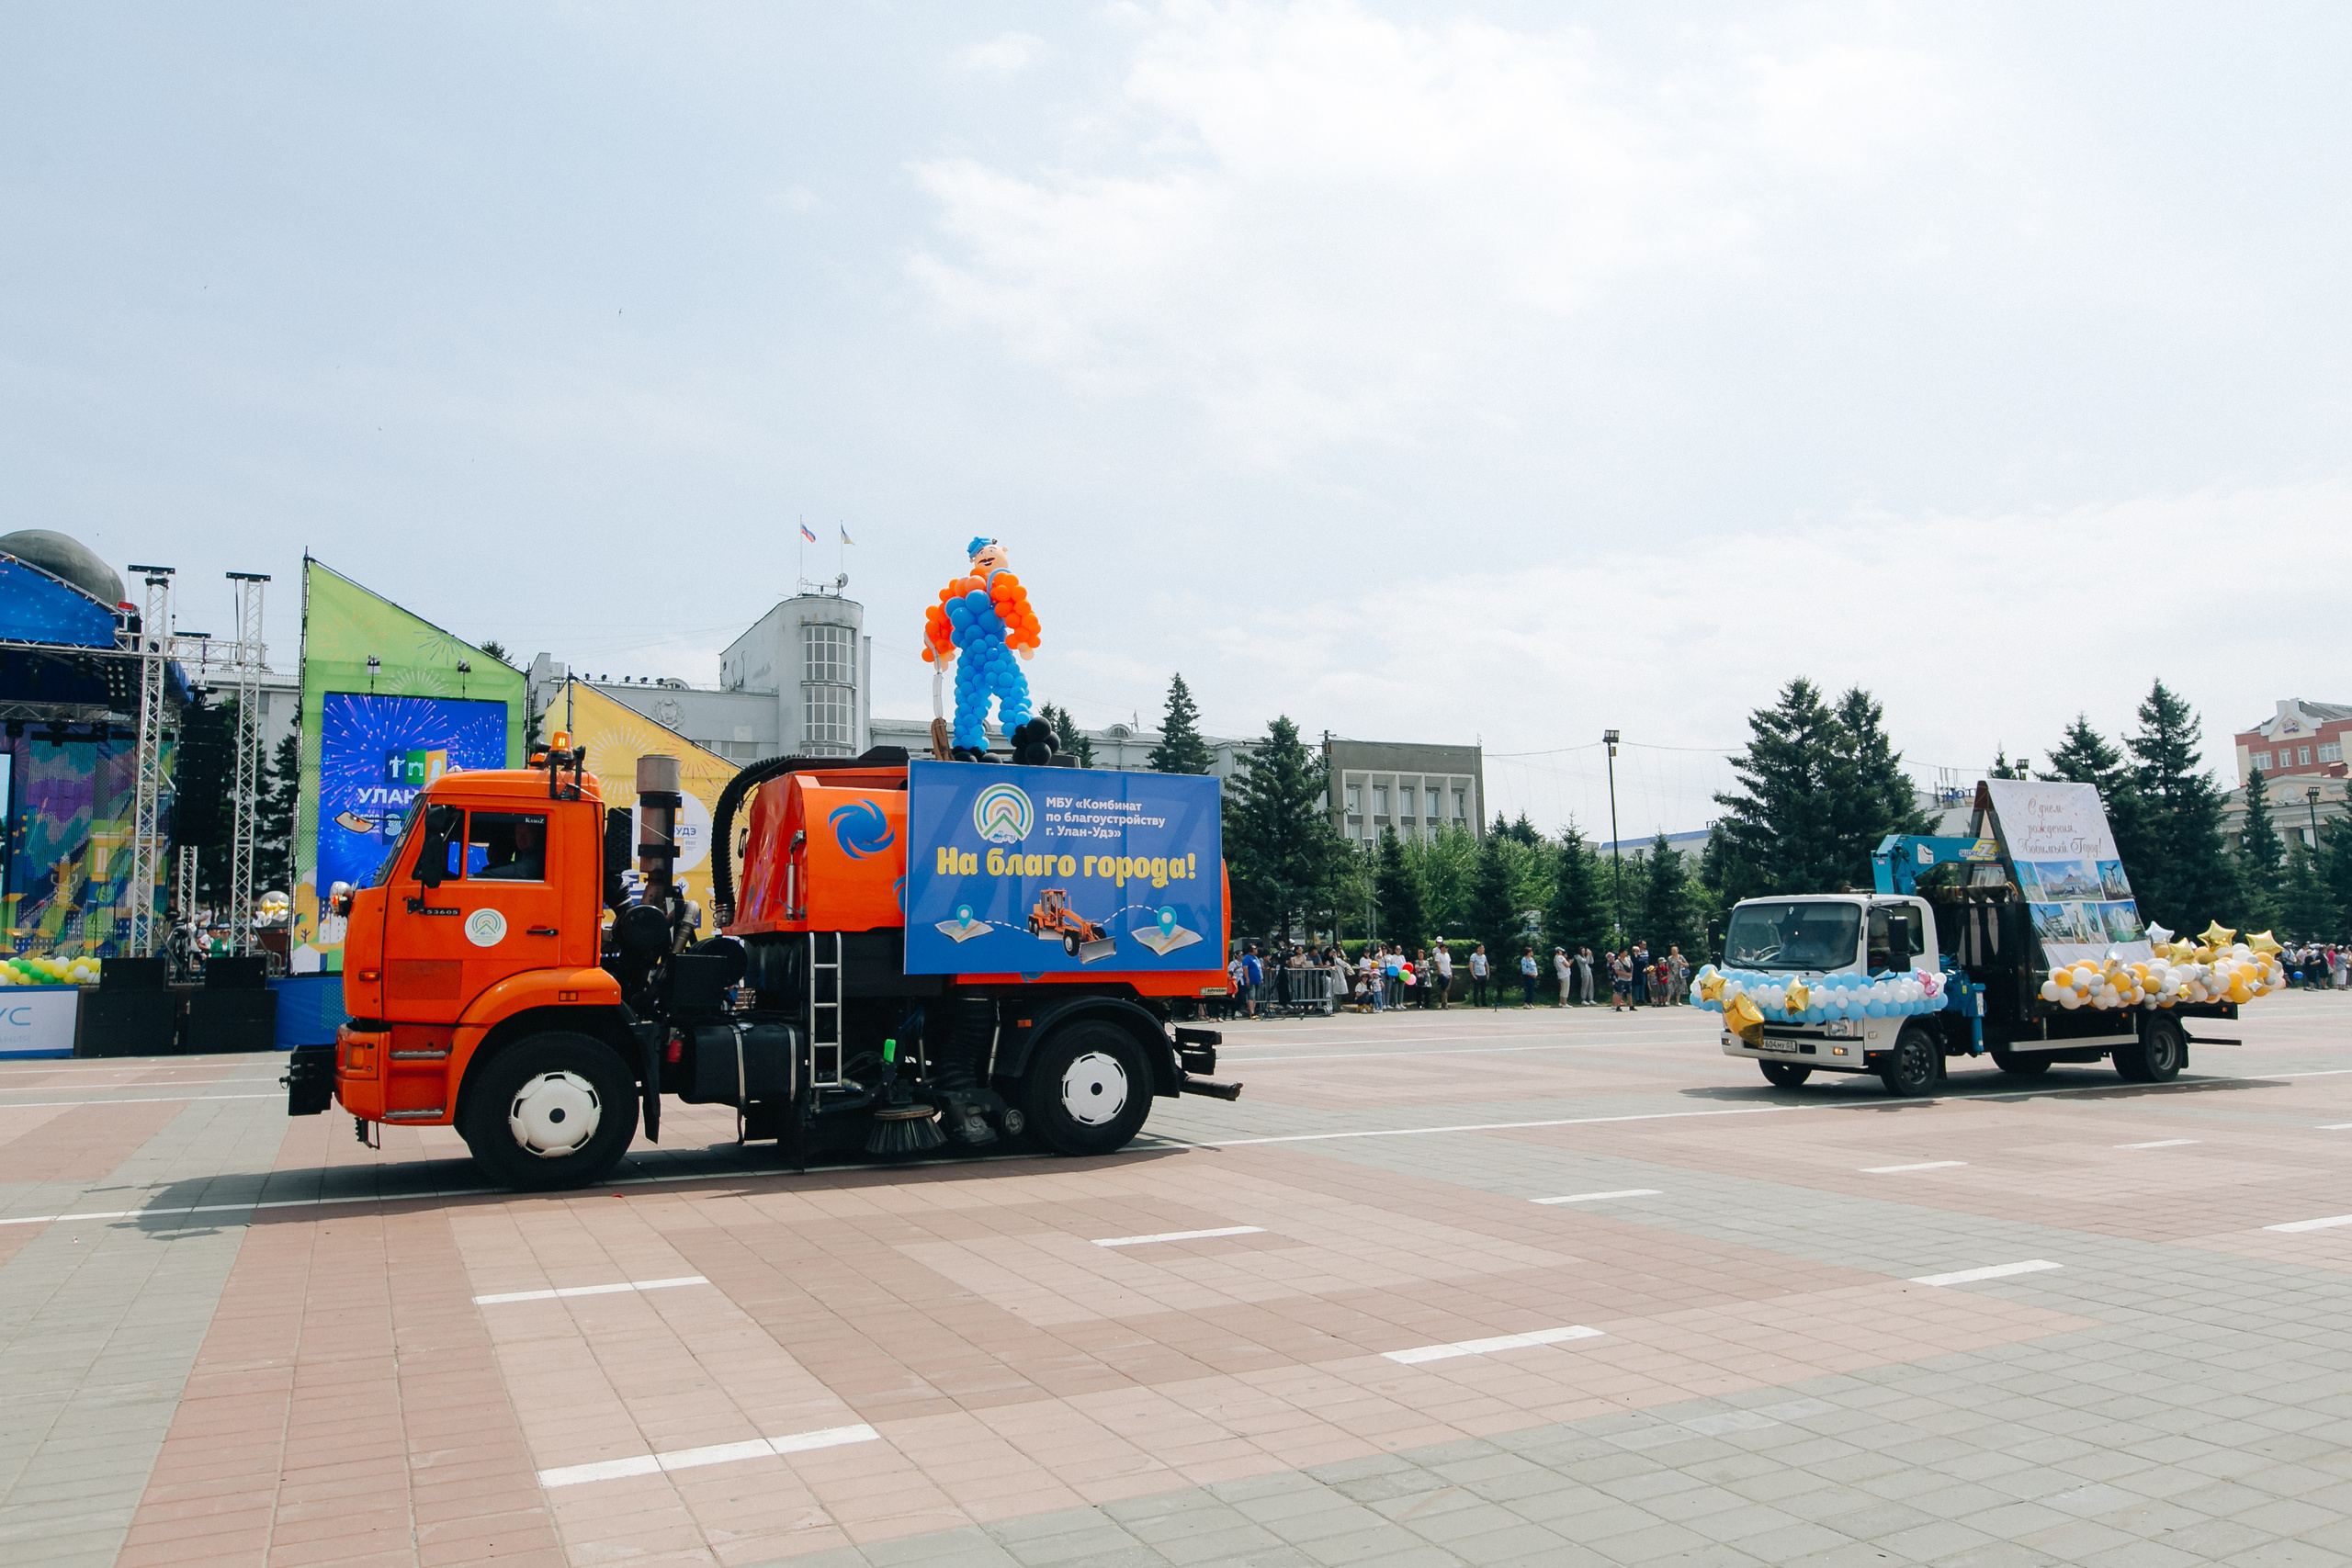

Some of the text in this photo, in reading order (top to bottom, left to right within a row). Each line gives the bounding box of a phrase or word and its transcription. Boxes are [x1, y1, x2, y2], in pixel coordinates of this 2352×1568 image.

[1046, 796, 1142, 811] МБУ «Комбинат
[2028, 797, 2063, 818] С днем
[1046, 812, 1166, 829] по благоустройству
[2027, 818, 2077, 839] рождения,
[1046, 826, 1122, 839] г. Улан-Удэ»
[2070, 837, 2102, 858] Город!
[937, 847, 1196, 887] На благо города!
